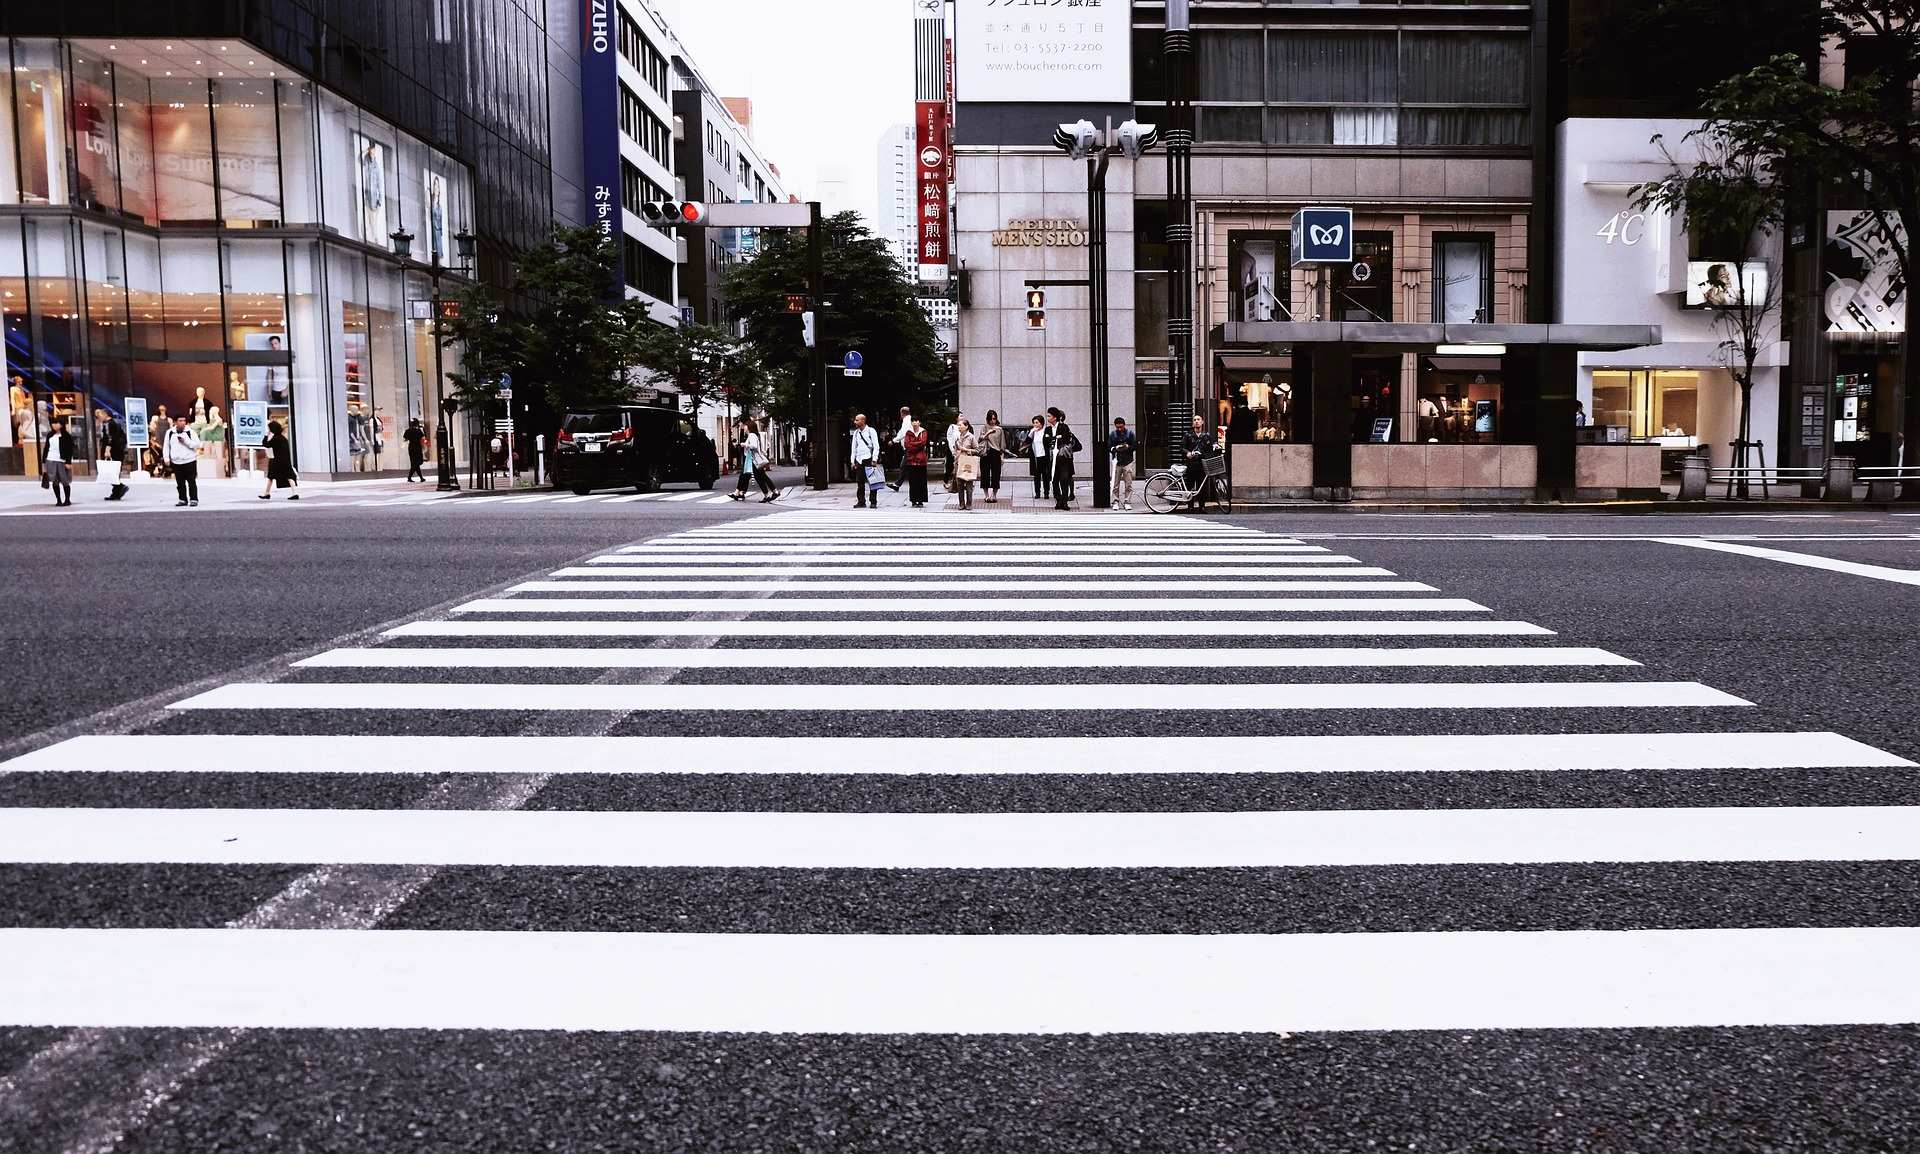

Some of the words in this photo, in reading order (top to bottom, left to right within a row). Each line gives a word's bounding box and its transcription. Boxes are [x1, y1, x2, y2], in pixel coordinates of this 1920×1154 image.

[985, 60, 1102, 71] www.boucheron.com
[1008, 218, 1078, 231] TEIJIN
[992, 231, 1043, 247] MEN'S
